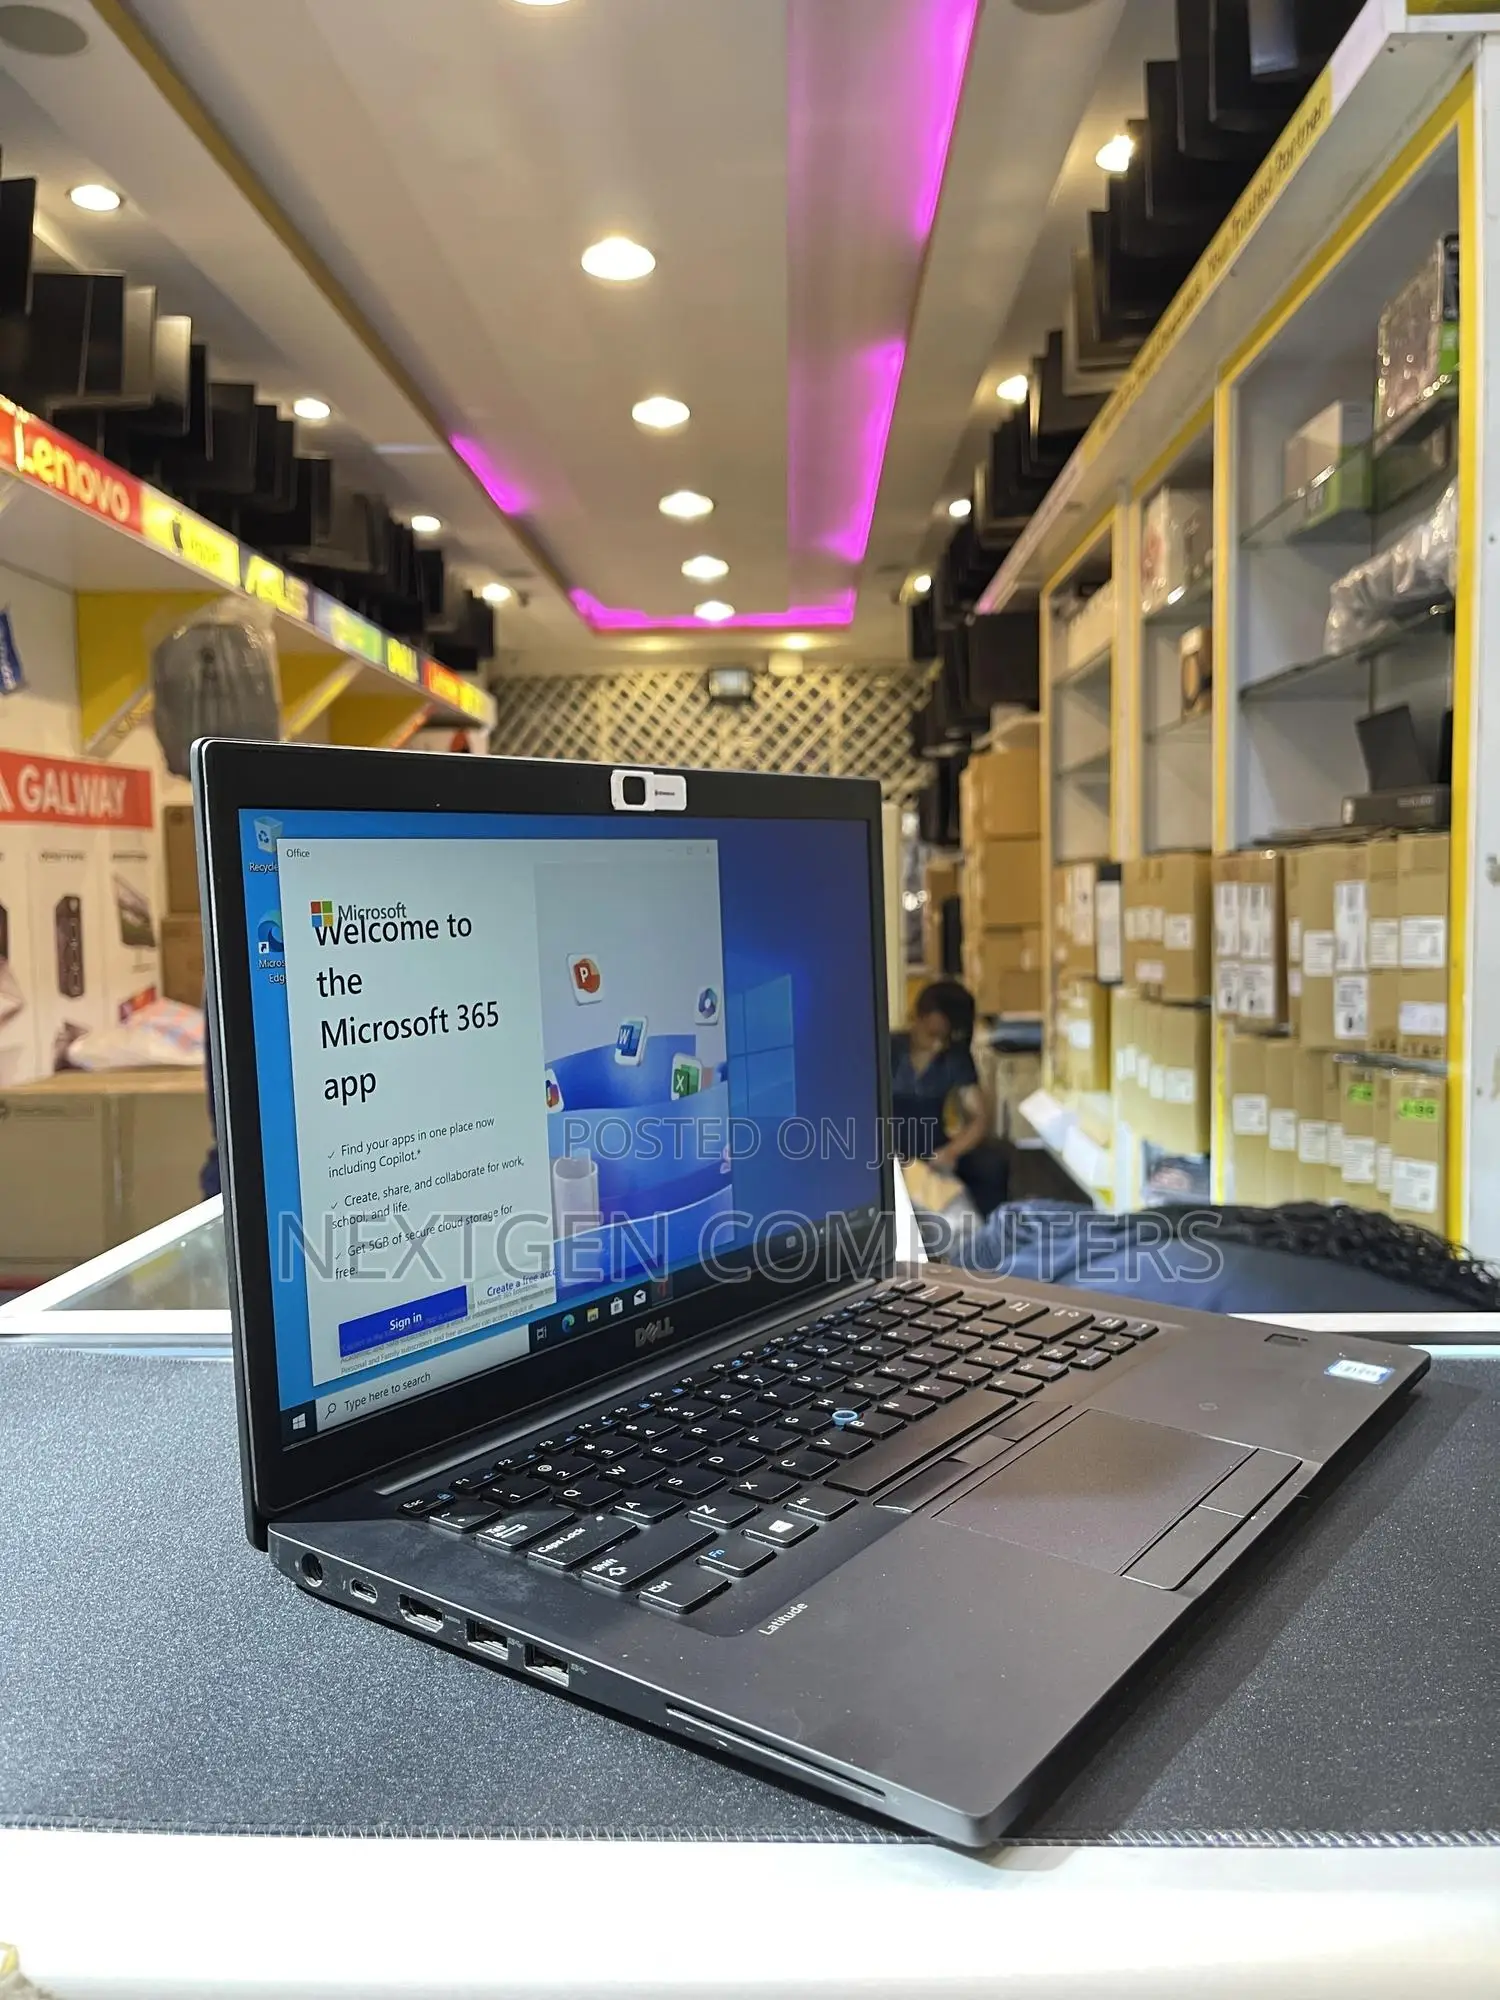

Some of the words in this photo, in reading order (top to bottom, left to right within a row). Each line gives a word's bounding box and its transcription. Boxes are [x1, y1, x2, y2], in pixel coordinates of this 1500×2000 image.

[14, 420, 131, 522] Lenovo
[17, 763, 127, 819] GALWAY
[286, 848, 310, 858] Office
[337, 902, 407, 921] Microsoft
[315, 913, 439, 946] Welcome
[447, 914, 472, 938] to
[316, 967, 363, 998] the
[321, 1006, 449, 1049] Microsoft
[457, 1001, 499, 1031] 365
[324, 1072, 377, 1106] app
[341, 1141, 363, 1156] Find
[366, 1139, 389, 1155] your
[391, 1132, 415, 1150] apps
[417, 1129, 427, 1141] in
[429, 1127, 447, 1139] one
[449, 1121, 474, 1137] place
[475, 1117, 495, 1129] now
[328, 1159, 376, 1178] including
[344, 1190, 380, 1207] Create,
[383, 1183, 412, 1199] share,
[414, 1178, 432, 1191] and
[435, 1167, 485, 1187] collaborate
[487, 1163, 500, 1173] for
[501, 1156, 525, 1170] work,
[332, 1212, 369, 1230] school,
[371, 1205, 390, 1219] and
[392, 1201, 410, 1213] life.
[347, 1243, 366, 1258] Get
[368, 1236, 389, 1252] 5GB
[392, 1232, 403, 1245] of
[405, 1225, 435, 1242] secure
[437, 1217, 463, 1234] cloud
[465, 1209, 499, 1226] storage
[500, 1203, 513, 1217] for
[335, 1267, 358, 1281] free.
[487, 1281, 513, 1297] Create
[515, 1280, 521, 1288] a
[522, 1273, 539, 1286] free
[389, 1318, 411, 1331] Sign
[412, 1312, 422, 1323] in
[635, 1317, 674, 1348] DELL
[344, 1399, 367, 1413] Type
[368, 1391, 389, 1403] here
[391, 1385, 401, 1394] to
[403, 1372, 431, 1390] search
[784, 1416, 800, 1424] G
[748, 1435, 760, 1443] F
[815, 1438, 831, 1446] V
[651, 1446, 668, 1454] E
[708, 1456, 724, 1464] D
[781, 1459, 796, 1467] C
[537, 1464, 552, 1472] @
[605, 1465, 627, 1476] W
[667, 1477, 684, 1486] S
[739, 1481, 758, 1490] X
[563, 1489, 582, 1497] Q
[403, 1499, 424, 1509] Esc
[625, 1501, 641, 1509] A
[697, 1504, 717, 1515] Z
[485, 1525, 508, 1534] Tab
[538, 1539, 565, 1552] Caps
[560, 1528, 586, 1542] Lock
[708, 1549, 725, 1558] Fn
[591, 1557, 619, 1572] Shift
[648, 1580, 674, 1593] Ctrl
[758, 1603, 808, 1635] Latitude
